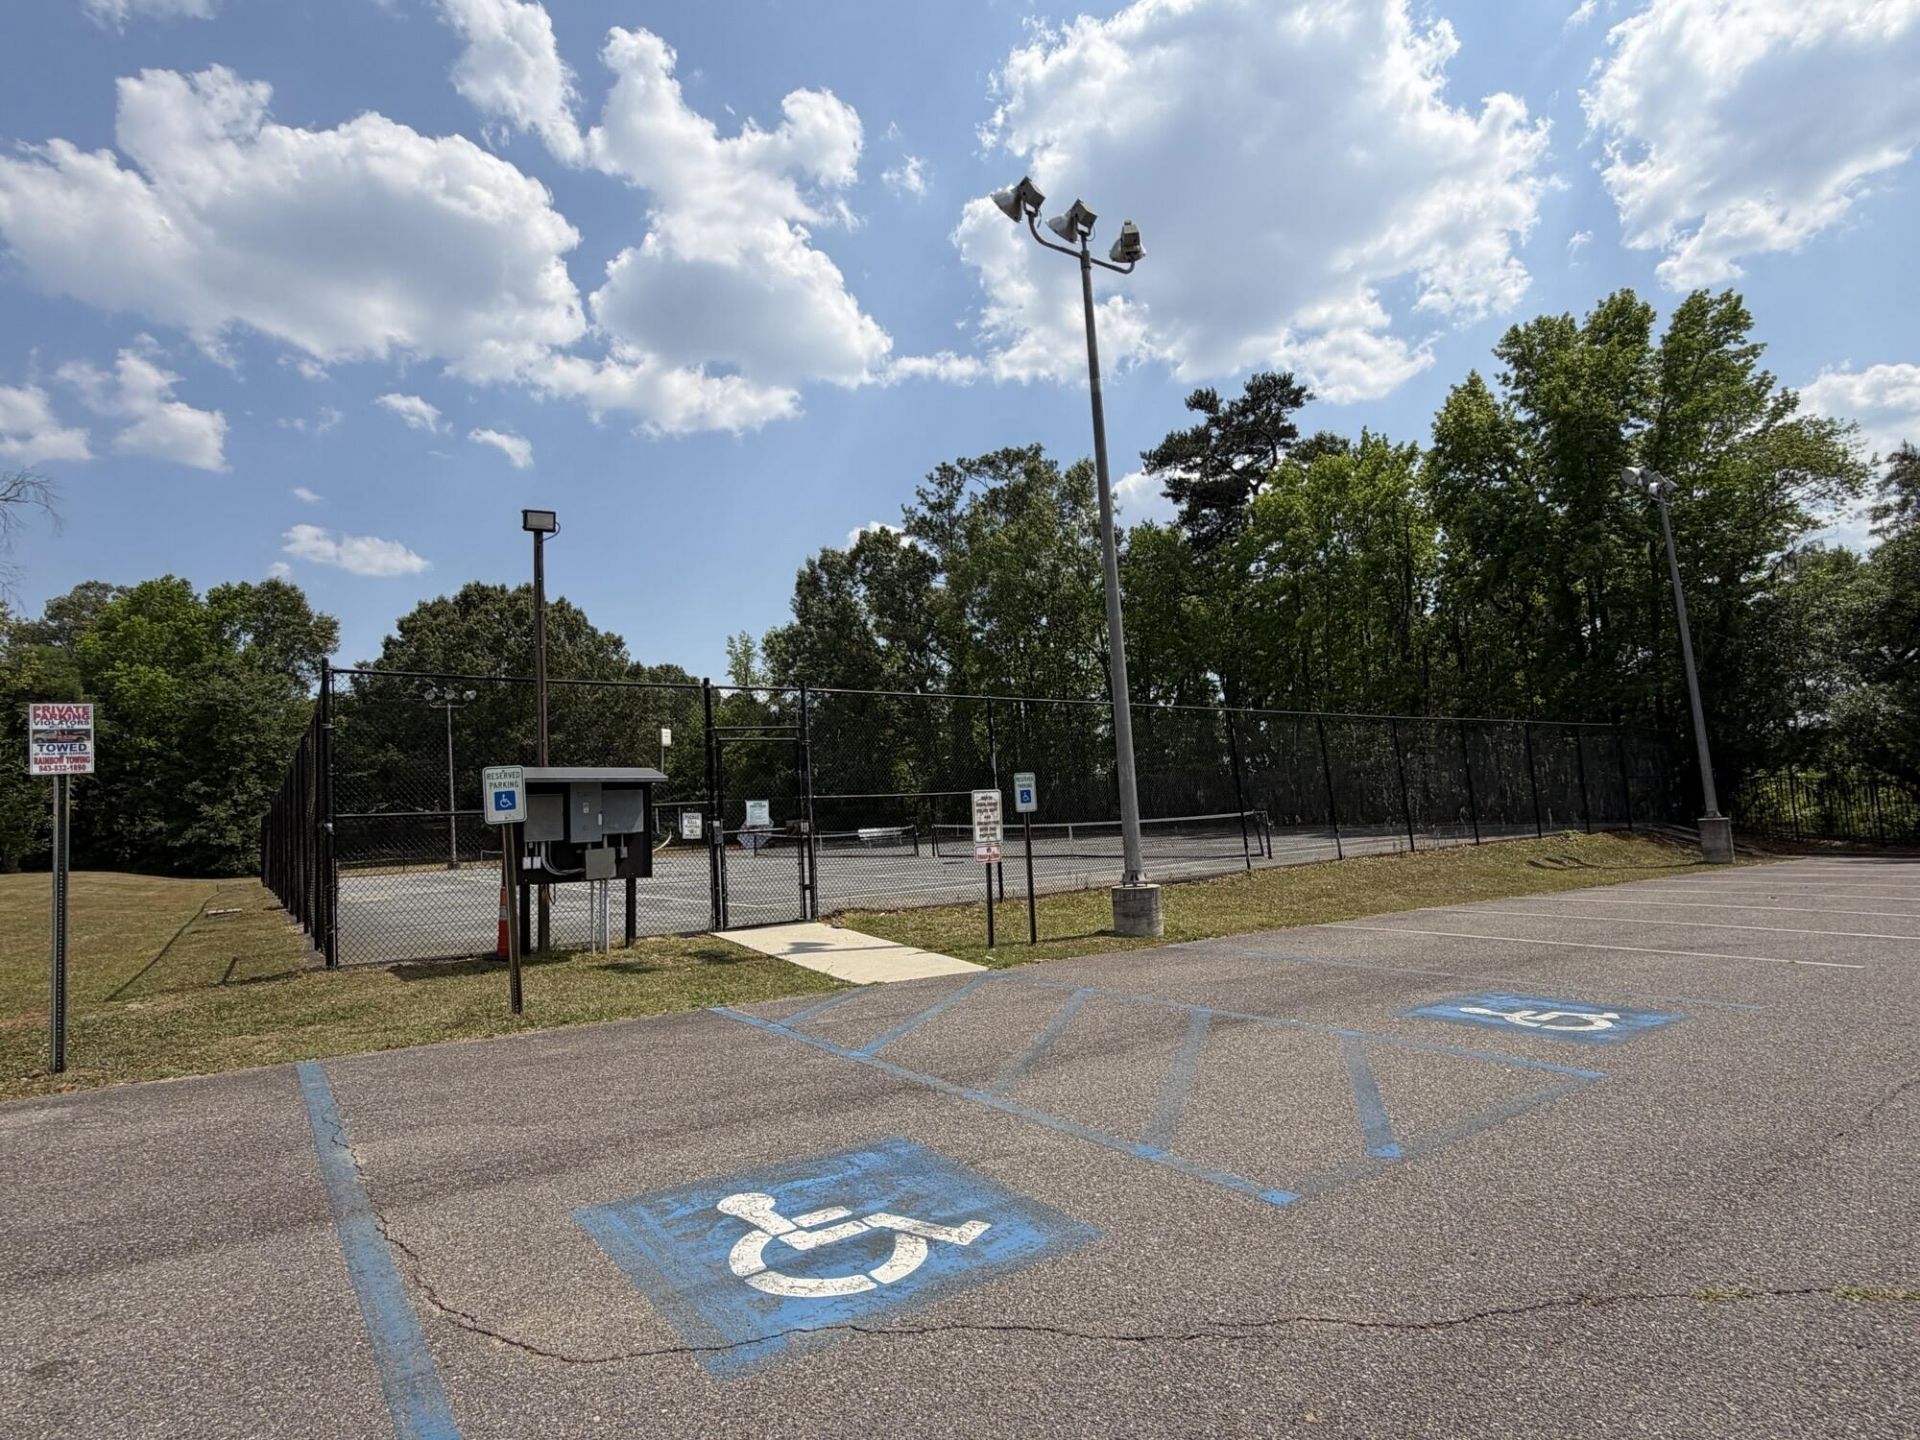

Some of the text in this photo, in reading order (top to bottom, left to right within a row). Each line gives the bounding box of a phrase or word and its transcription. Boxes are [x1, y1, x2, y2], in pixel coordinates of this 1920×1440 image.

[33, 706, 90, 714] PRIVATE
[37, 744, 87, 752] TOWED
[34, 755, 91, 765] RAINBOW TOWING
[487, 771, 520, 780] RESERVED
[489, 780, 519, 790] PARKING
